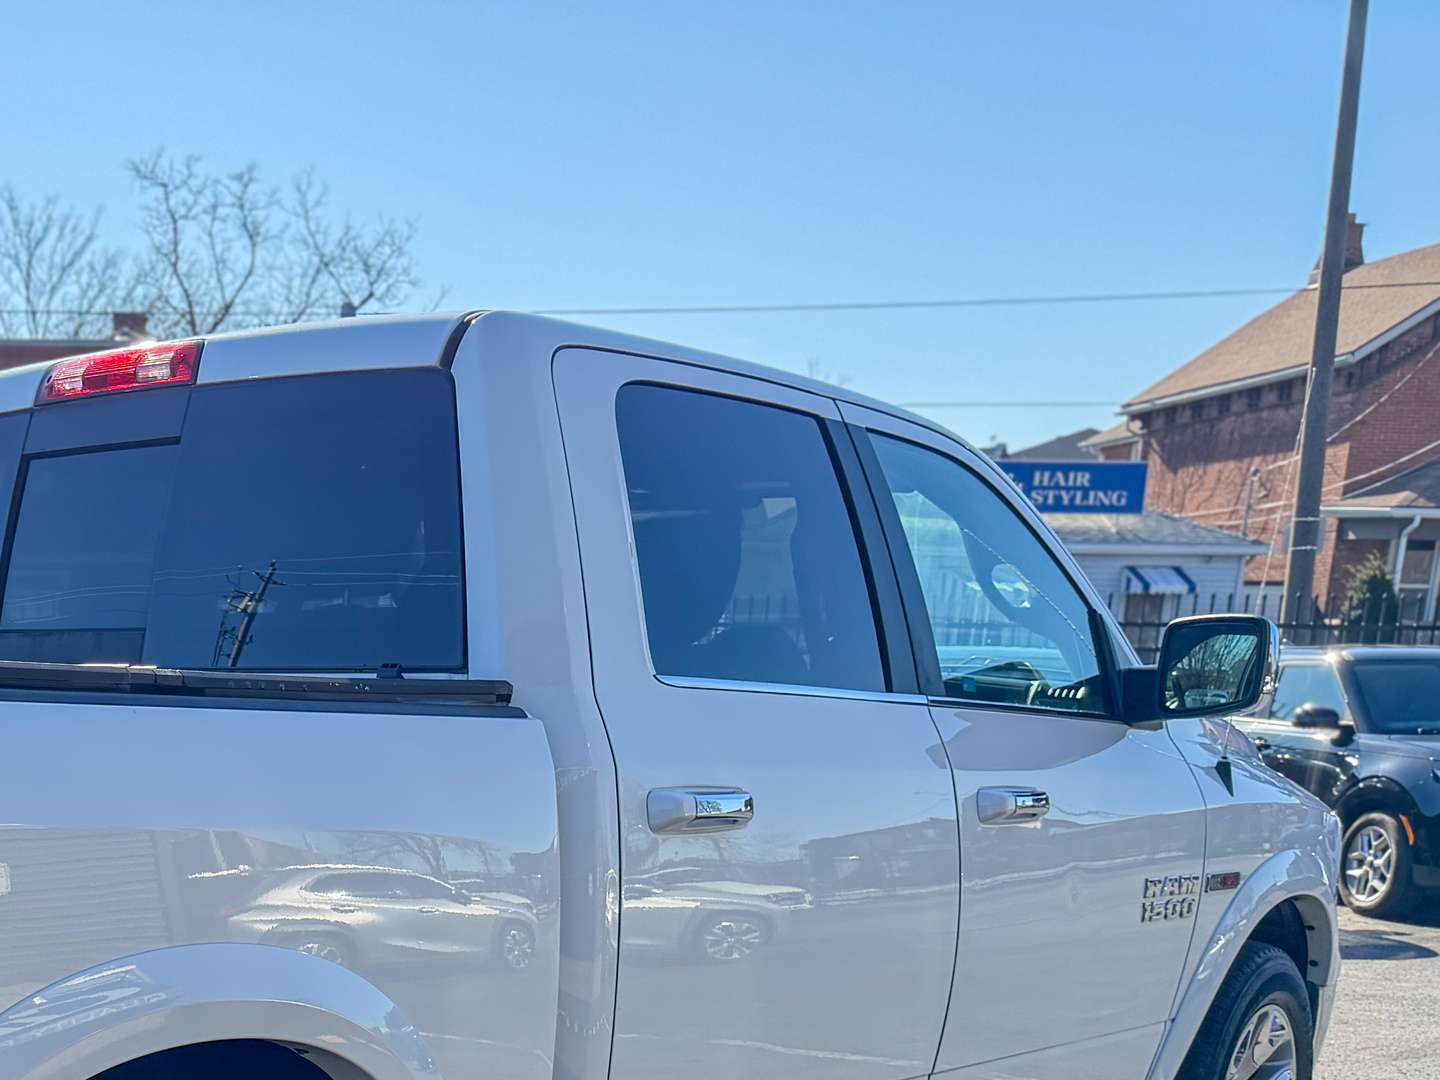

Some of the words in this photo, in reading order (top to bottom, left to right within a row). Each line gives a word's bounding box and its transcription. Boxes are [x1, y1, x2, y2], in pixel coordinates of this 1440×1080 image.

[1032, 470, 1091, 487] HAIR
[1031, 489, 1128, 507] STYLING
[1143, 875, 1200, 899] RAM
[1140, 898, 1196, 923] 1500
